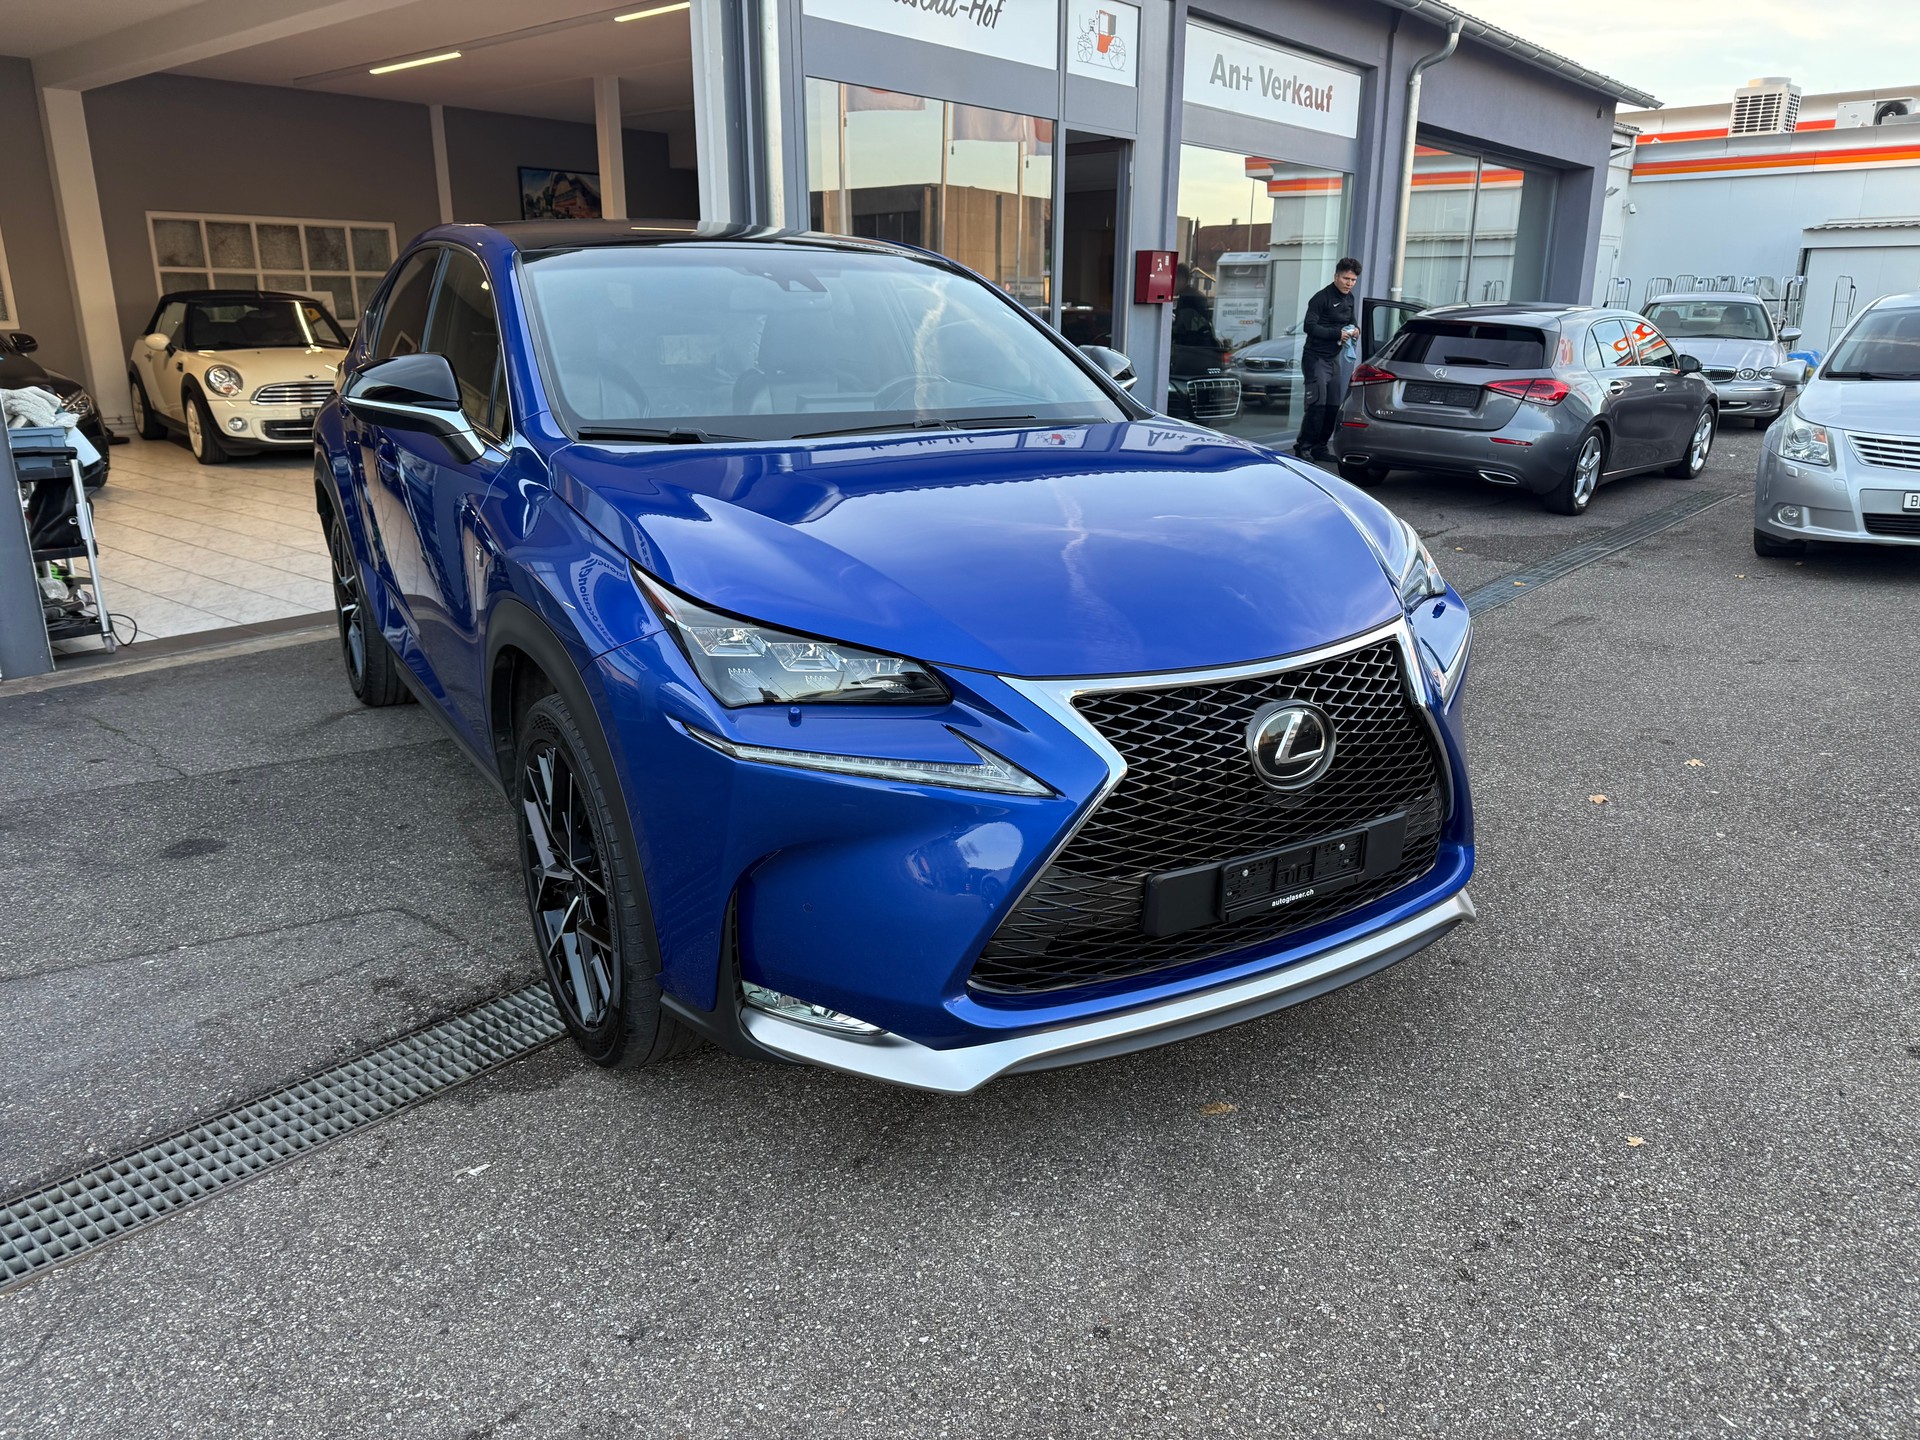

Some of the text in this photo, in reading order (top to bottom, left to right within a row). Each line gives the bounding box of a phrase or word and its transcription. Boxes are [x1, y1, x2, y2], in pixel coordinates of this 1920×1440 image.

[1209, 53, 1333, 112] An+ Verkauf
[1271, 888, 1314, 907] autoglaser.ch
